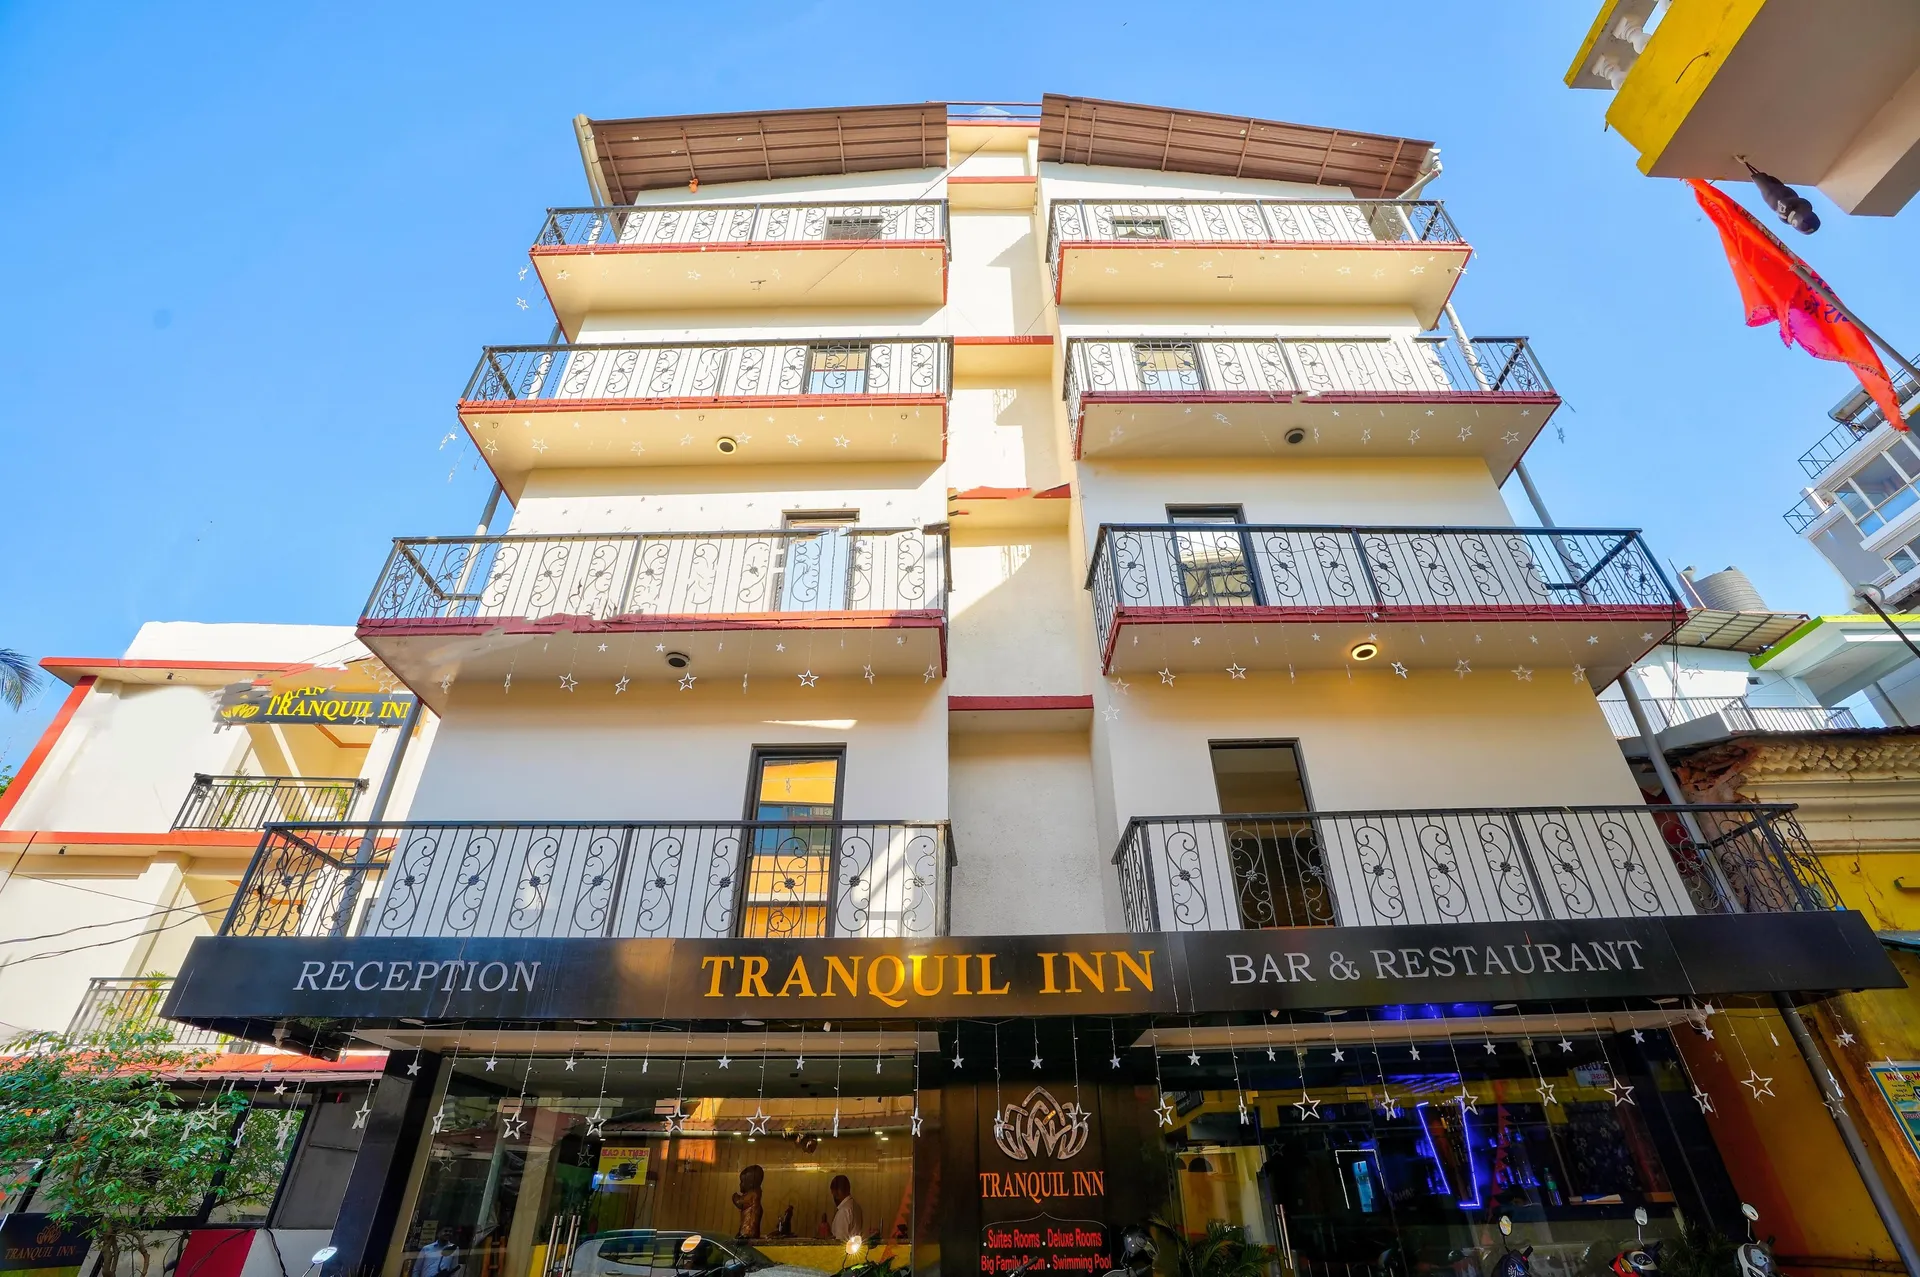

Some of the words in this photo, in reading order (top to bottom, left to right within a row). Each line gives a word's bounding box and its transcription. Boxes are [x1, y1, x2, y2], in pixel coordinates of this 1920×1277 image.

[292, 960, 541, 992] RECEPTION
[1226, 952, 1316, 985] BAR
[1329, 951, 1361, 981] &
[1370, 940, 1645, 980] RESTAURANT
[701, 953, 1010, 1008] TRANQUIL
[1036, 950, 1155, 993] INN
[980, 1171, 1069, 1203] TRANQUIL
[1072, 1171, 1104, 1196] INN
[4, 1246, 54, 1260] TRANQUIL
[57, 1245, 77, 1256] INN
[988, 1229, 1013, 1248] Suites
[1014, 1229, 1040, 1248] Rooms
[1047, 1228, 1074, 1247] Deluxe
[1075, 1228, 1102, 1247] Rooms
[981, 1255, 995, 1275] Big
[1052, 1254, 1093, 1274] Swimming
[1094, 1253, 1112, 1270] Pool
